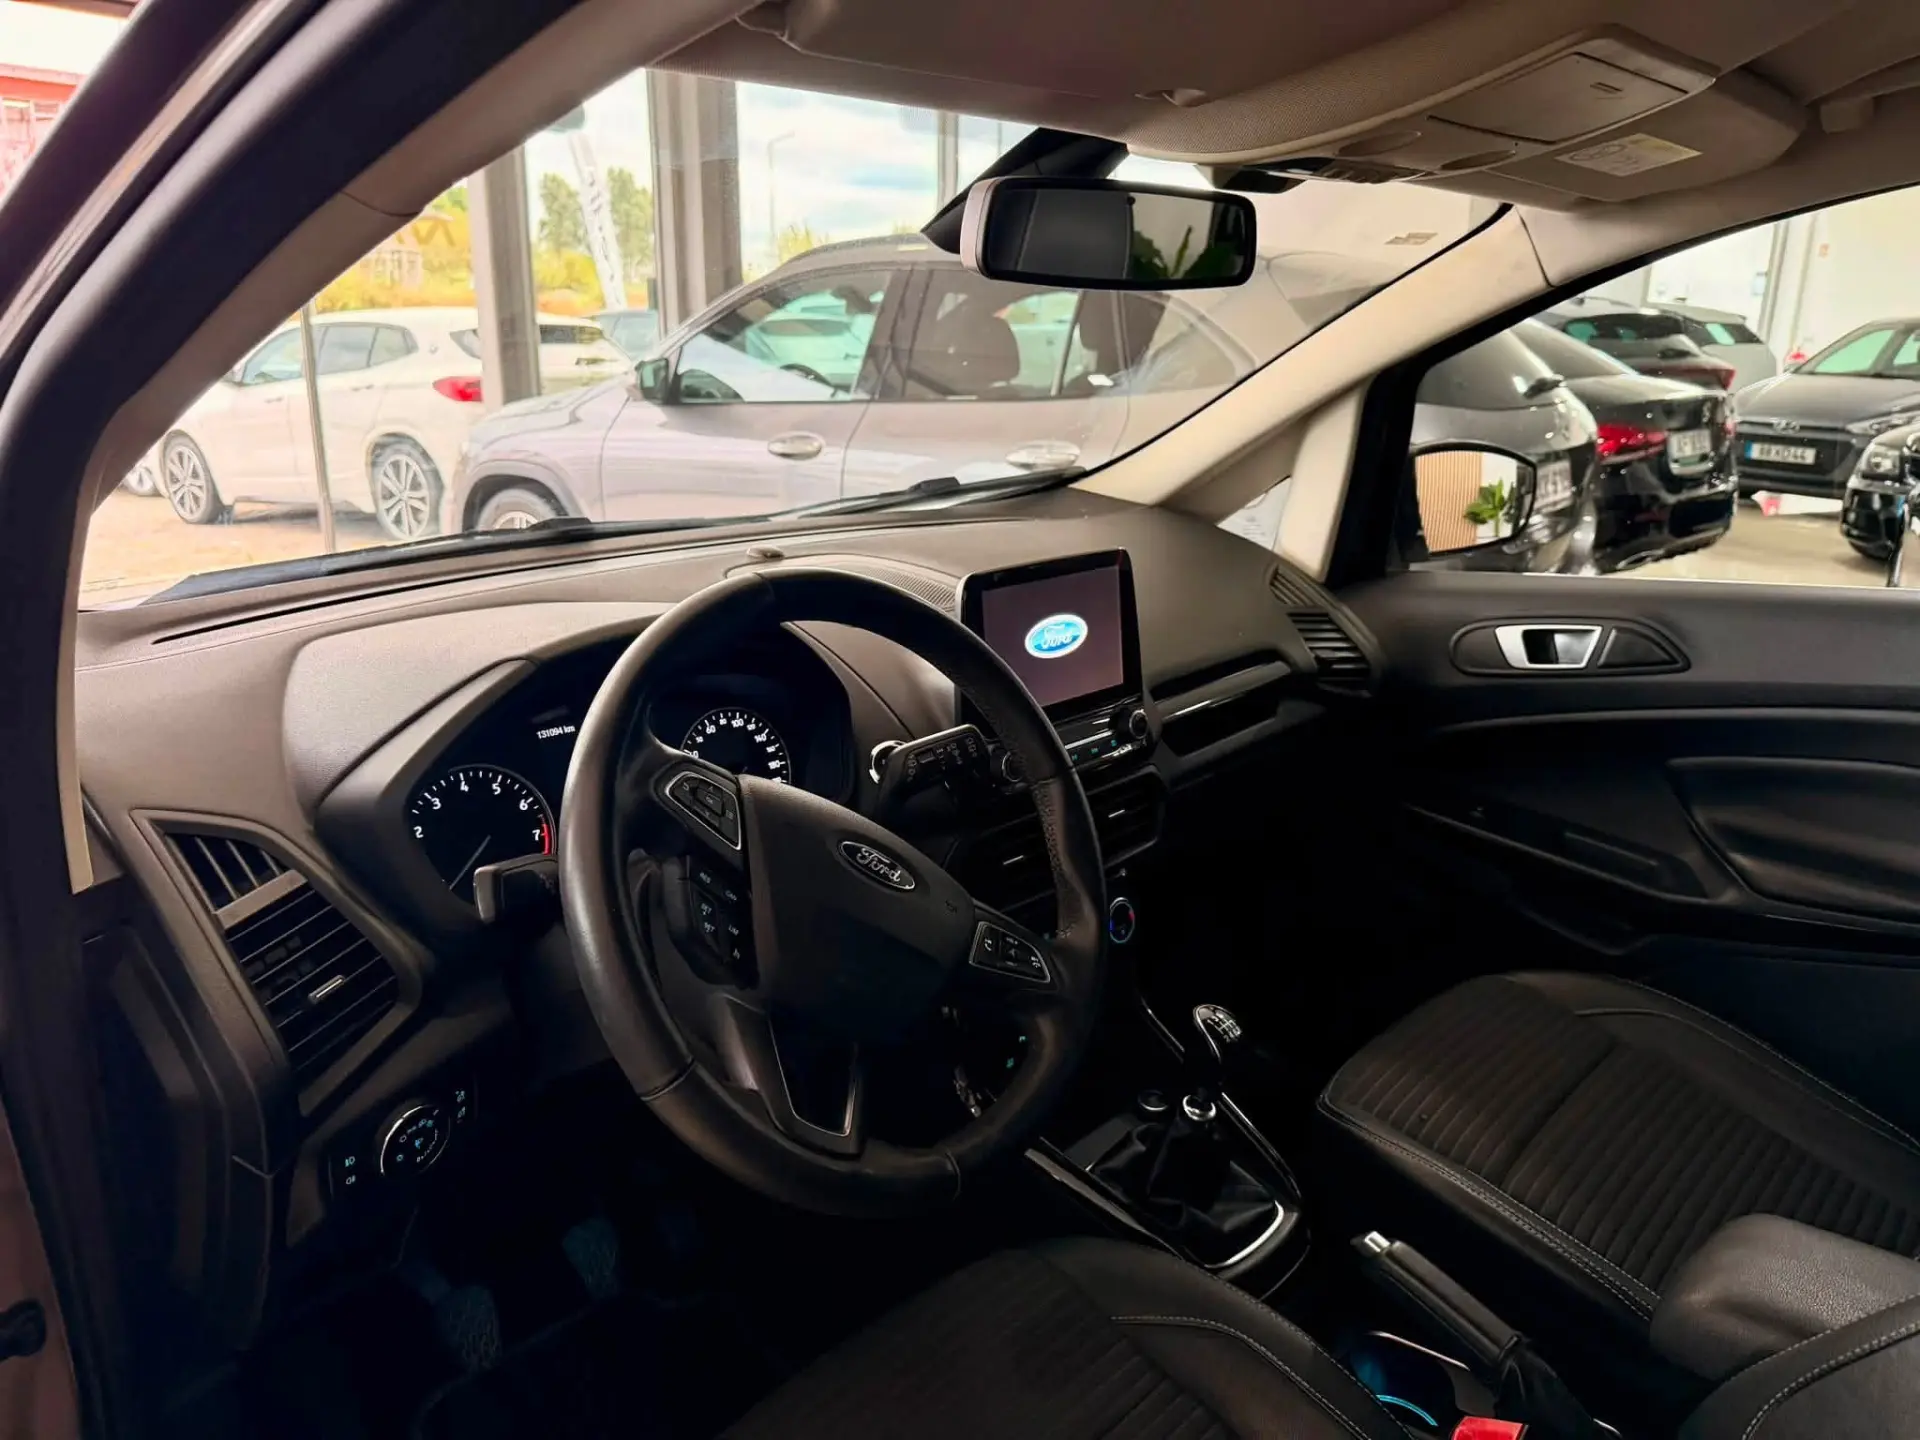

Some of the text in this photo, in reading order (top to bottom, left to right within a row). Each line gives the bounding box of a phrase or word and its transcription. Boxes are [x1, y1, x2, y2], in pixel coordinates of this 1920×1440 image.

[731, 718, 744, 728] 100
[706, 725, 716, 734] 60
[754, 733, 767, 743] 140
[460, 781, 469, 792] 4
[492, 783, 501, 795] 5
[431, 798, 441, 810] 3
[519, 800, 529, 811] 6
[413, 826, 424, 838] 2
[532, 829, 541, 841] 7
